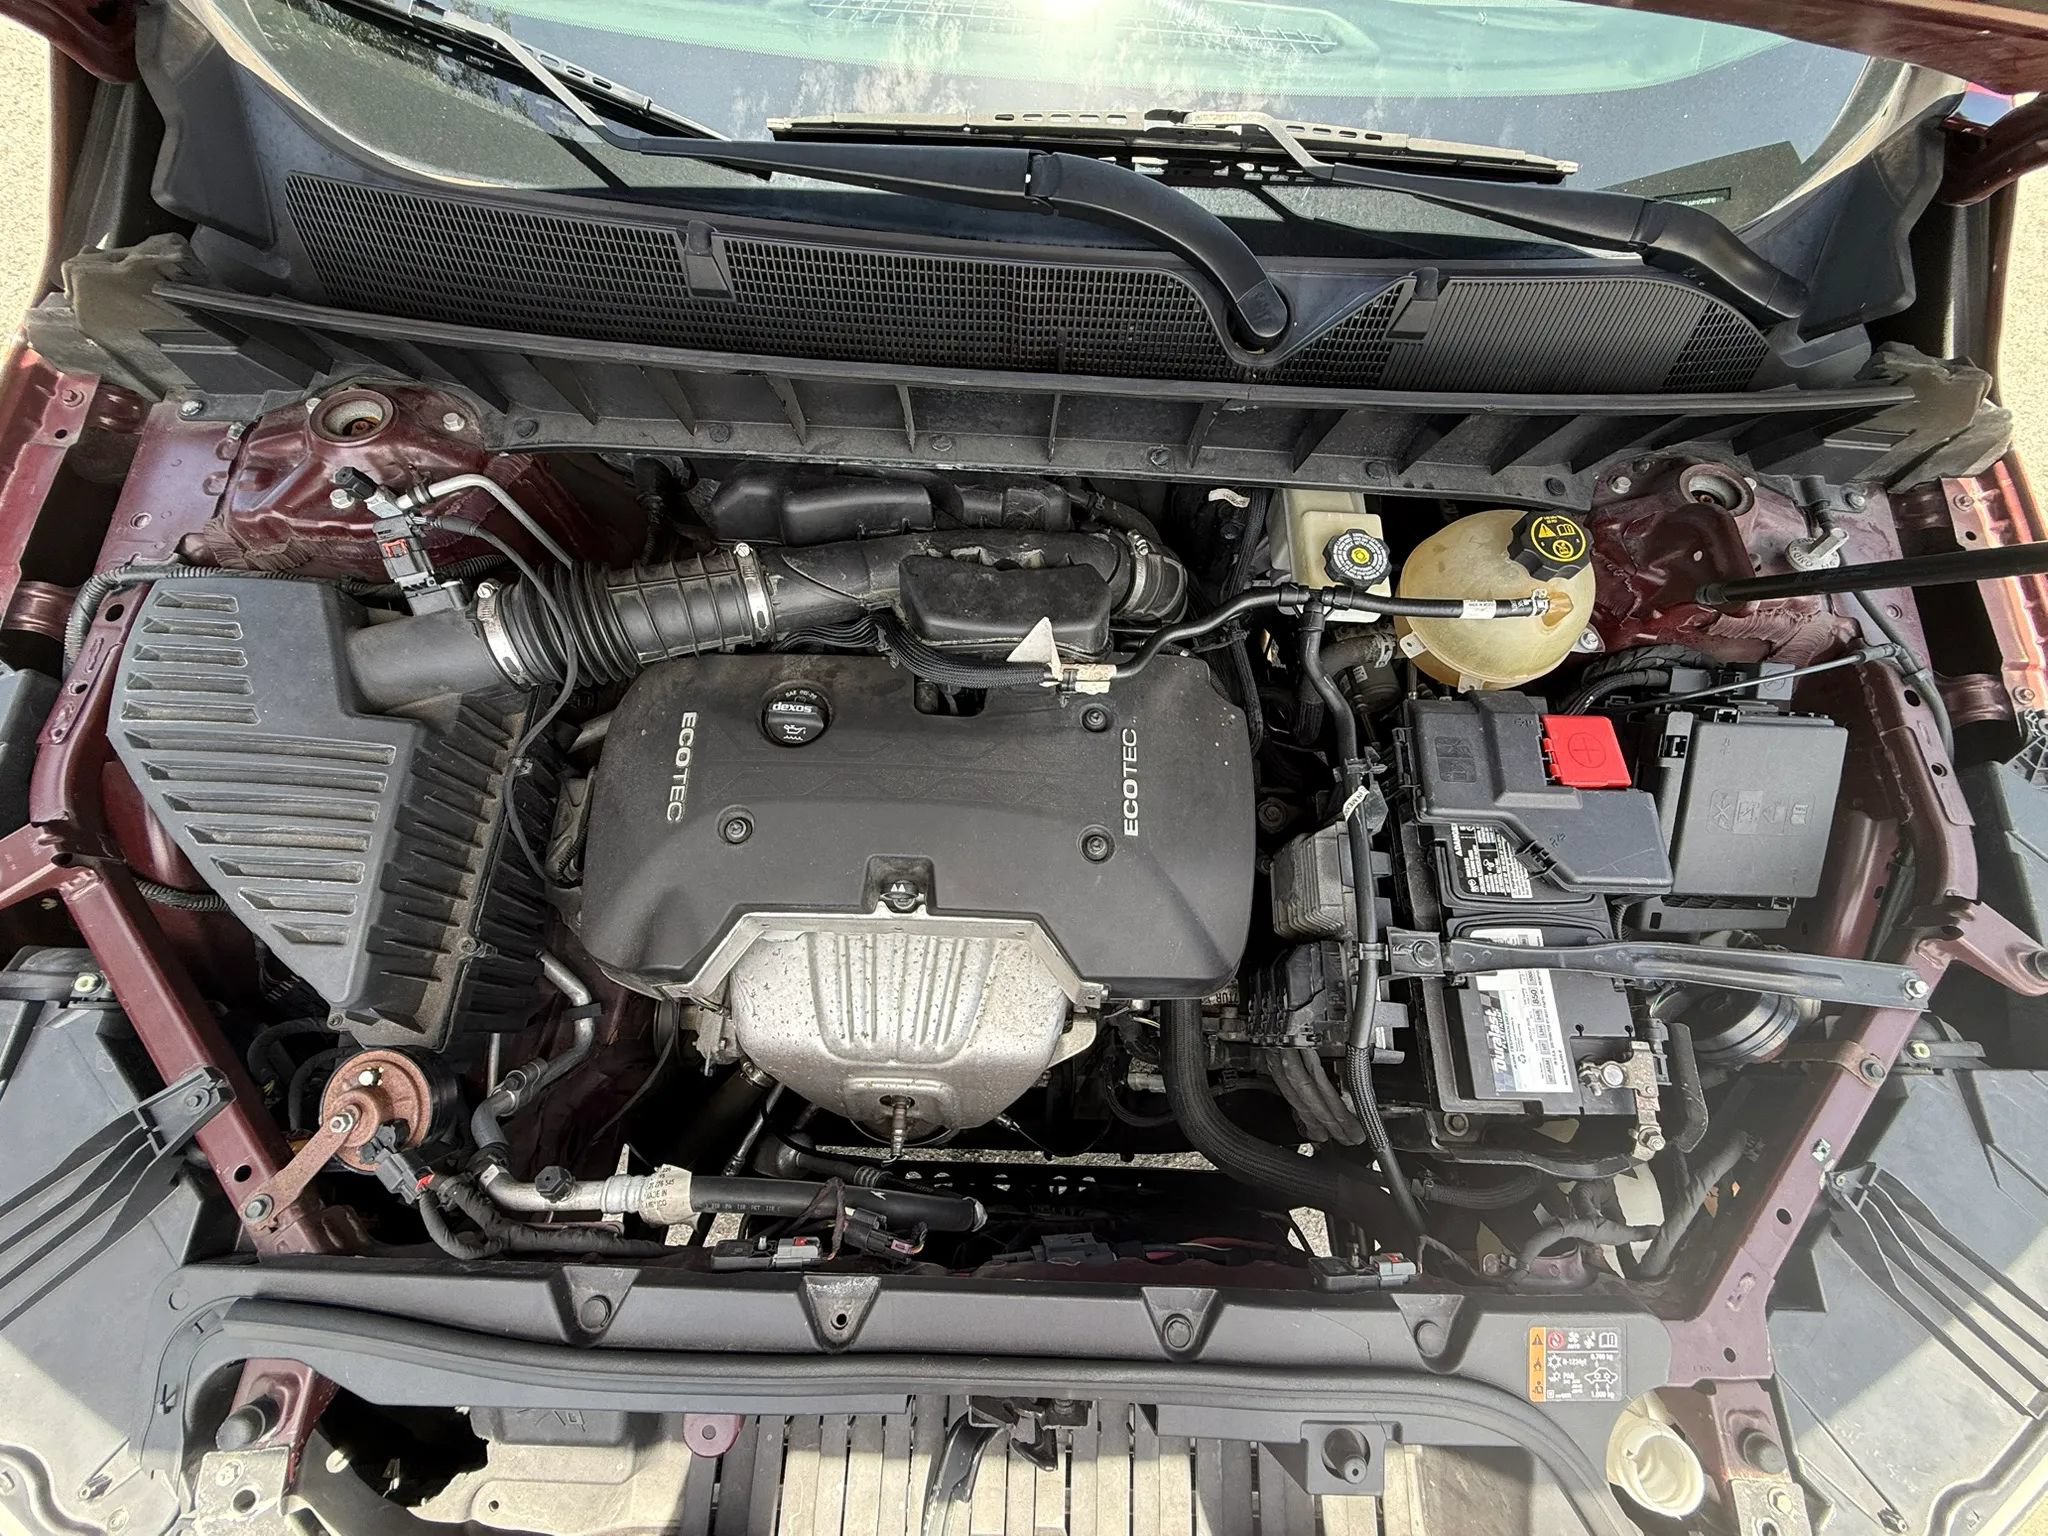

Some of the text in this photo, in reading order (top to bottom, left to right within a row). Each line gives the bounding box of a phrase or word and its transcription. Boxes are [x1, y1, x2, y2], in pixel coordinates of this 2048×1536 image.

[772, 702, 812, 713] dexos
[667, 712, 697, 822] ECOTEC
[1122, 728, 1139, 837] ECOTEC
[1530, 989, 1540, 1005] 850
[1484, 1008, 1508, 1074] Duralast
